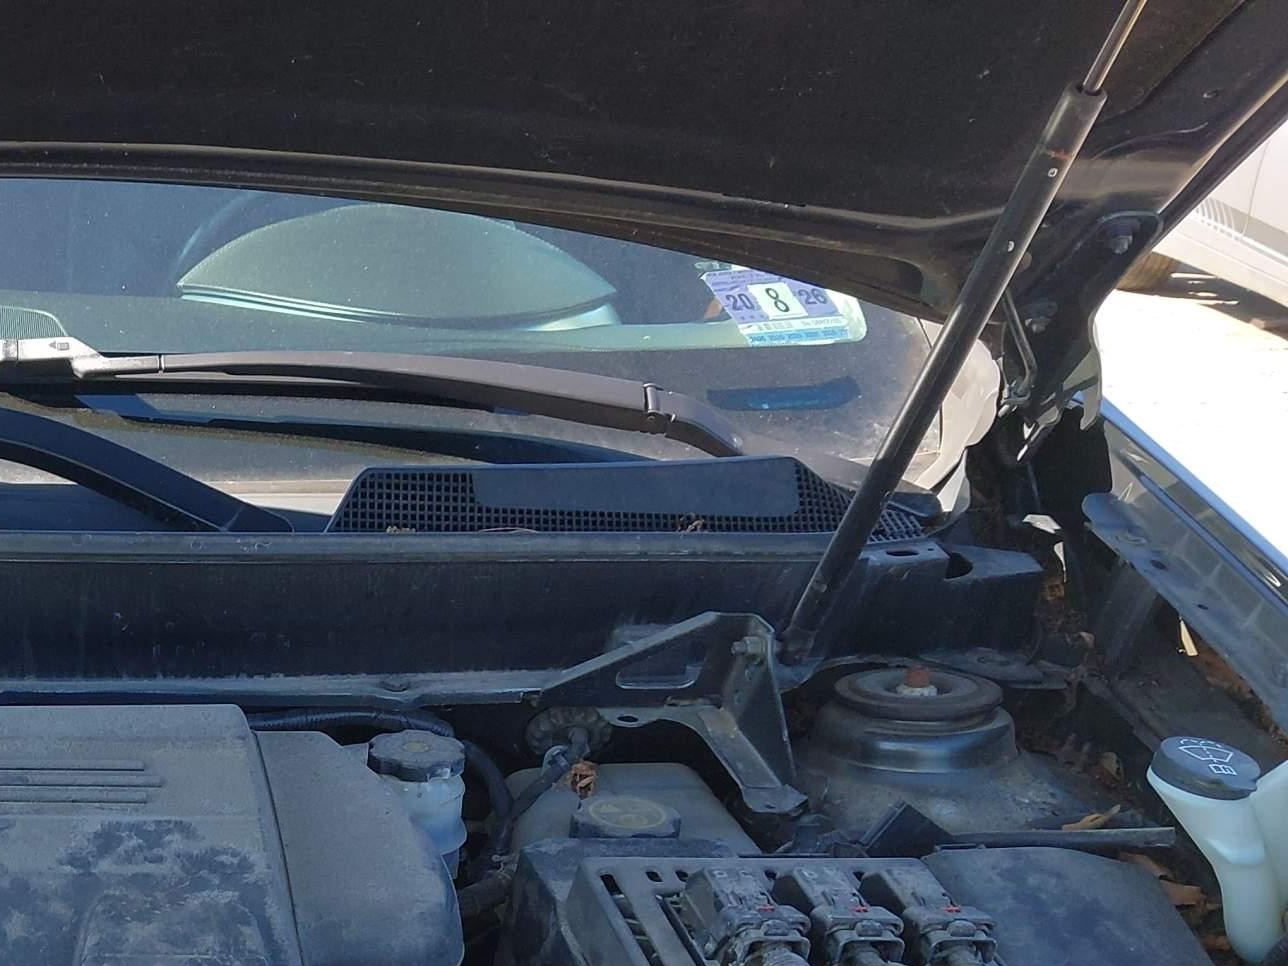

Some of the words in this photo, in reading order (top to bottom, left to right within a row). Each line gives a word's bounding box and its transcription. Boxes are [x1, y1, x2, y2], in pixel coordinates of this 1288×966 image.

[725, 293, 755, 311] 20
[765, 287, 790, 312] 8
[797, 287, 829, 305] 26
